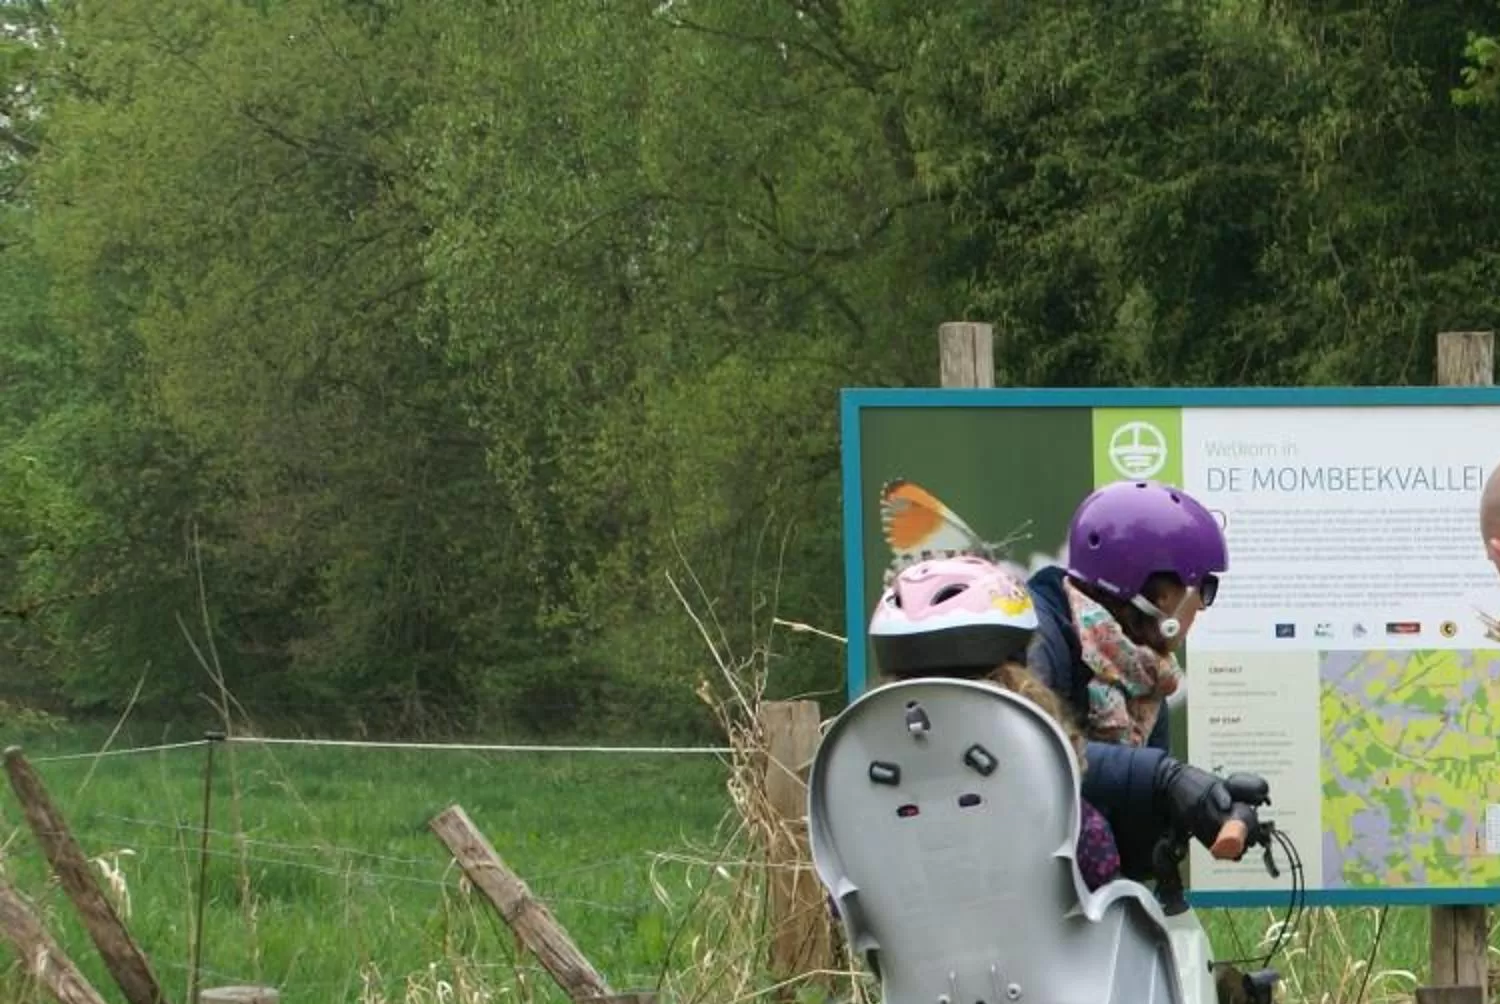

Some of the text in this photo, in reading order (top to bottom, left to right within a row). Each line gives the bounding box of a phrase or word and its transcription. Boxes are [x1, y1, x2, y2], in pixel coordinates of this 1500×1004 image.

[1204, 438, 1278, 457] Welkom
[1206, 465, 1483, 492] DE MOMBEEKVALLEI
